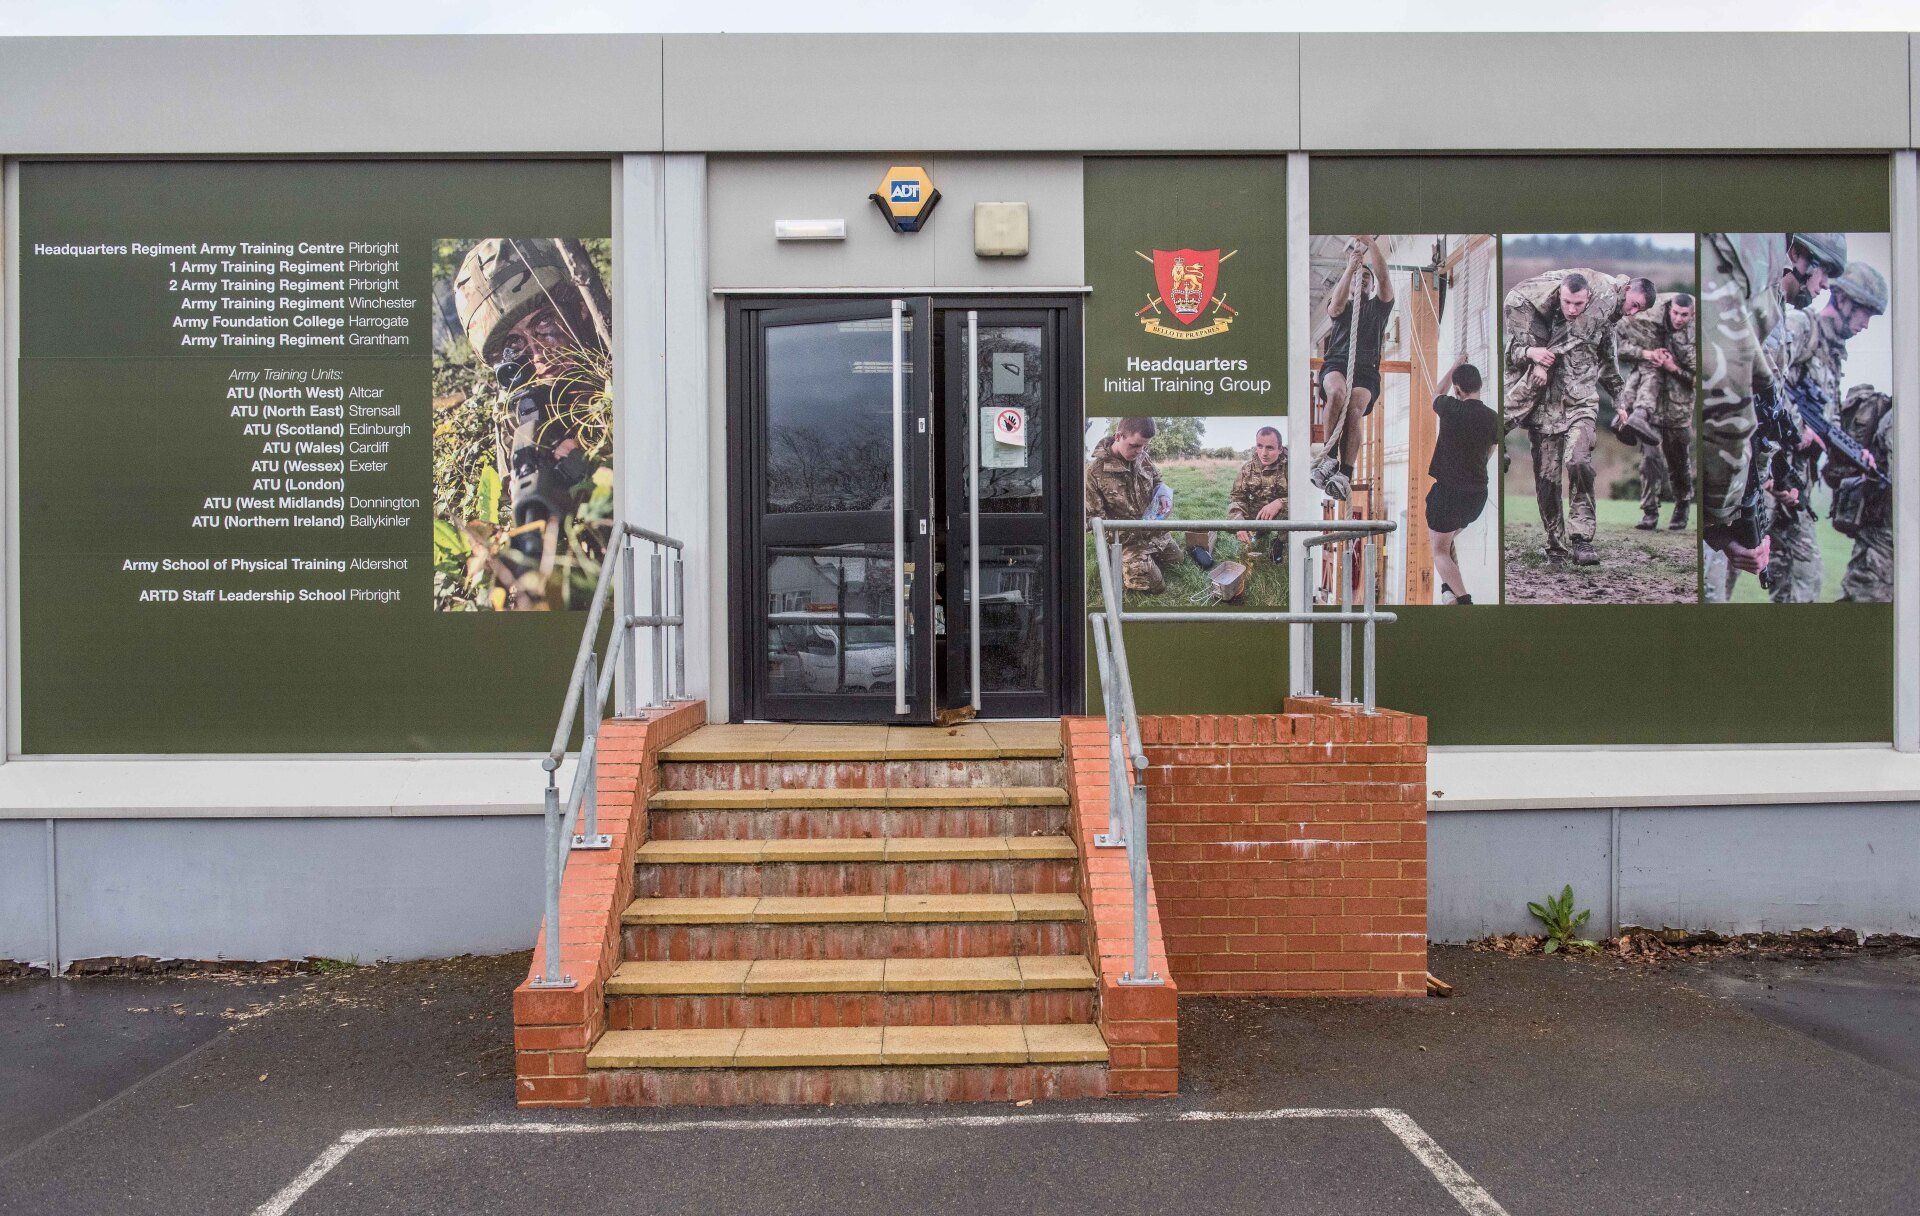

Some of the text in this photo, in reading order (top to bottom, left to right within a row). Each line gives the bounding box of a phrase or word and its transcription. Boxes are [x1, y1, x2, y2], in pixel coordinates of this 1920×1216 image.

[891, 184, 920, 198] ADT
[35, 242, 399, 257] Headquarters Regiment Army Training Centre Pirbright
[169, 260, 399, 275] 1 Army Training Regiment Pirbright
[169, 279, 399, 293] 2 Army Training Regiment Pirbright
[181, 297, 416, 311] Army Training Regiment Winchester
[173, 315, 408, 329] Army Foundation College Harrogate
[181, 334, 408, 348] Army Training Regiment Grantham
[1127, 357, 1248, 374] Headquarters
[228, 369, 343, 382] Army Training Units:
[1104, 377, 1271, 395] Initial Training Group
[227, 387, 384, 401] ATU (North West) Altcar
[231, 405, 400, 419] ATU (North East) Strensall
[243, 423, 410, 437] ATU (Scotland) Edinburgh
[263, 442, 389, 455] ATU (Wales) Cardiff
[251, 460, 388, 474] ATU (Wessex) Exeter
[253, 478, 344, 492] ATU (London)
[204, 497, 419, 511] ATU (West Midlands) Donnington
[192, 515, 410, 529] ATU (Northern Ireland) Ballykinler
[123, 558, 408, 572] Army School of Physical Training Aldershot
[139, 589, 400, 603] ARTD Staff Leadership School Pirbright
